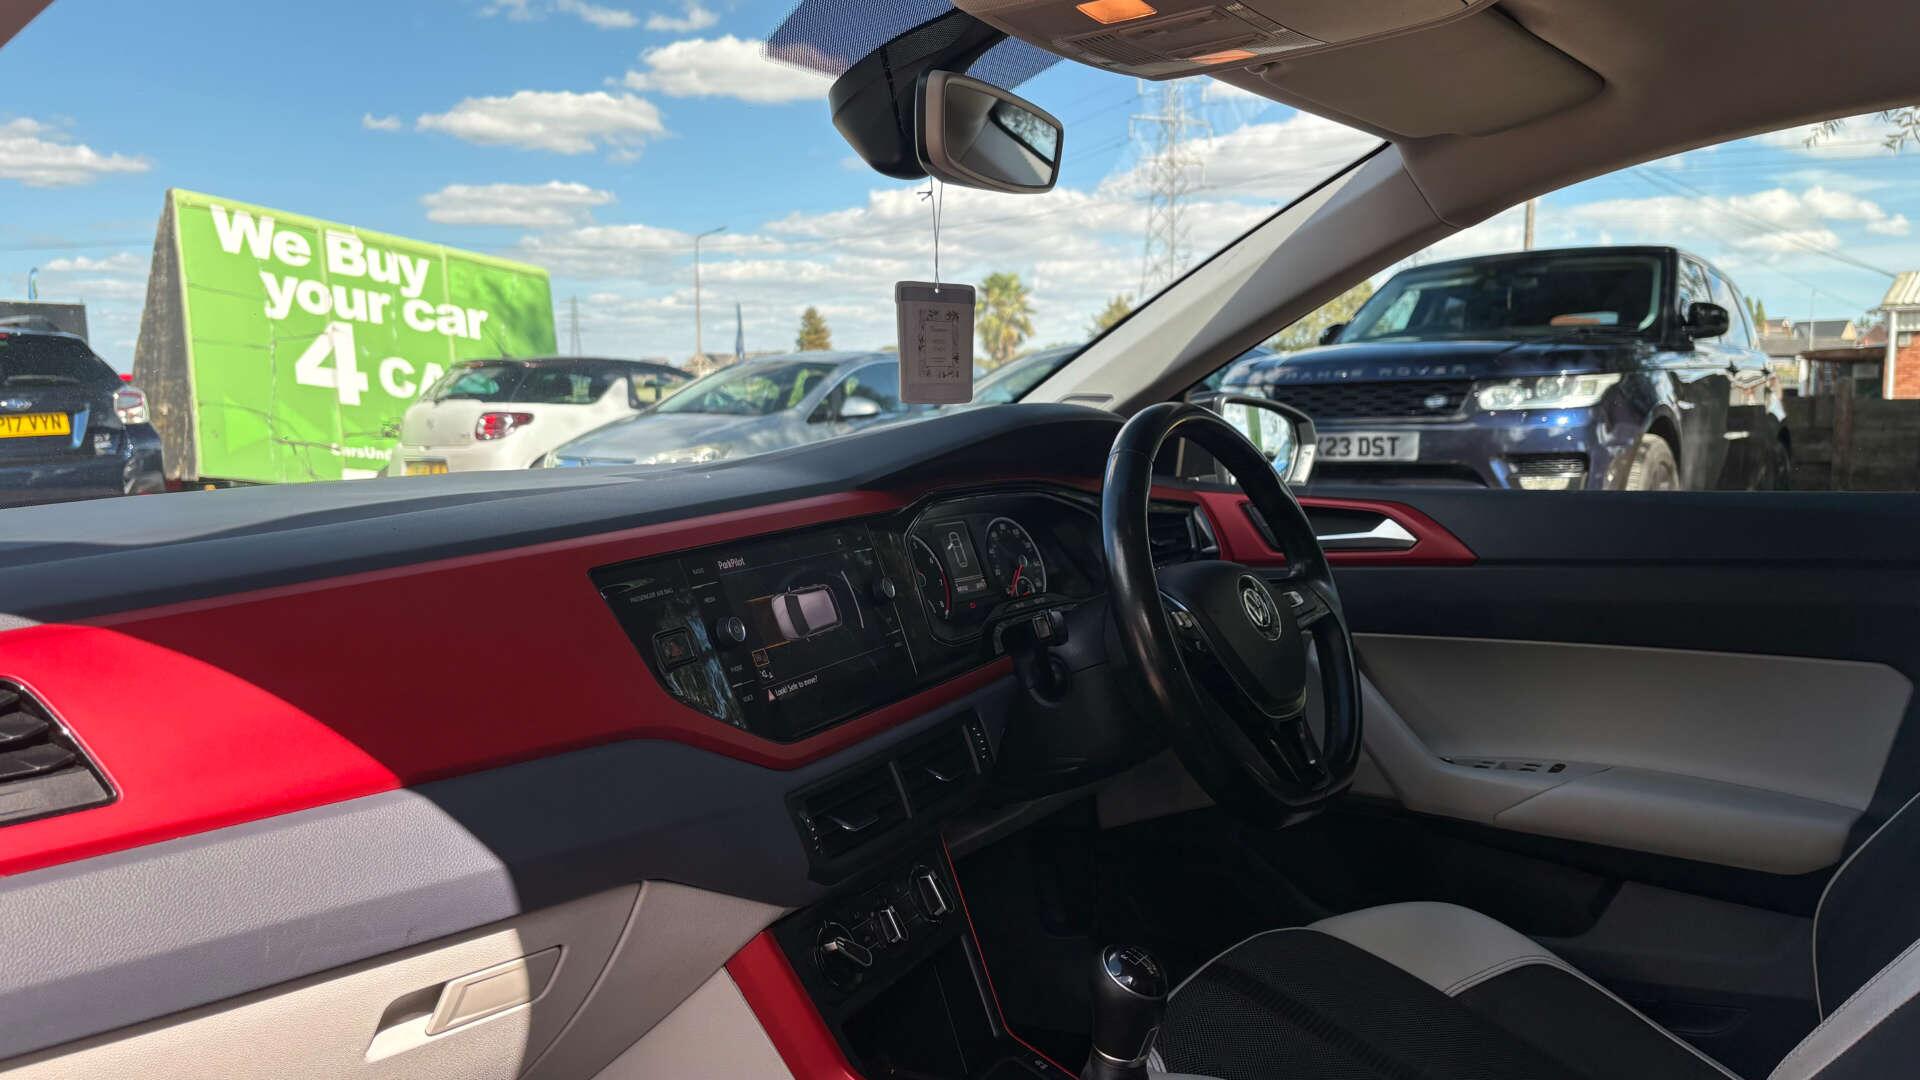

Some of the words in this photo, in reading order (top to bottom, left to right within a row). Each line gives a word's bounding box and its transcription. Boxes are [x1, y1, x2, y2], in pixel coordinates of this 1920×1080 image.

[210, 203, 312, 267] We
[325, 228, 430, 299] Buy
[259, 270, 392, 325] your
[402, 297, 488, 341] car
[295, 321, 369, 406] 4
[1358, 435, 1401, 457] DST
[717, 557, 746, 570] ParkPilot
